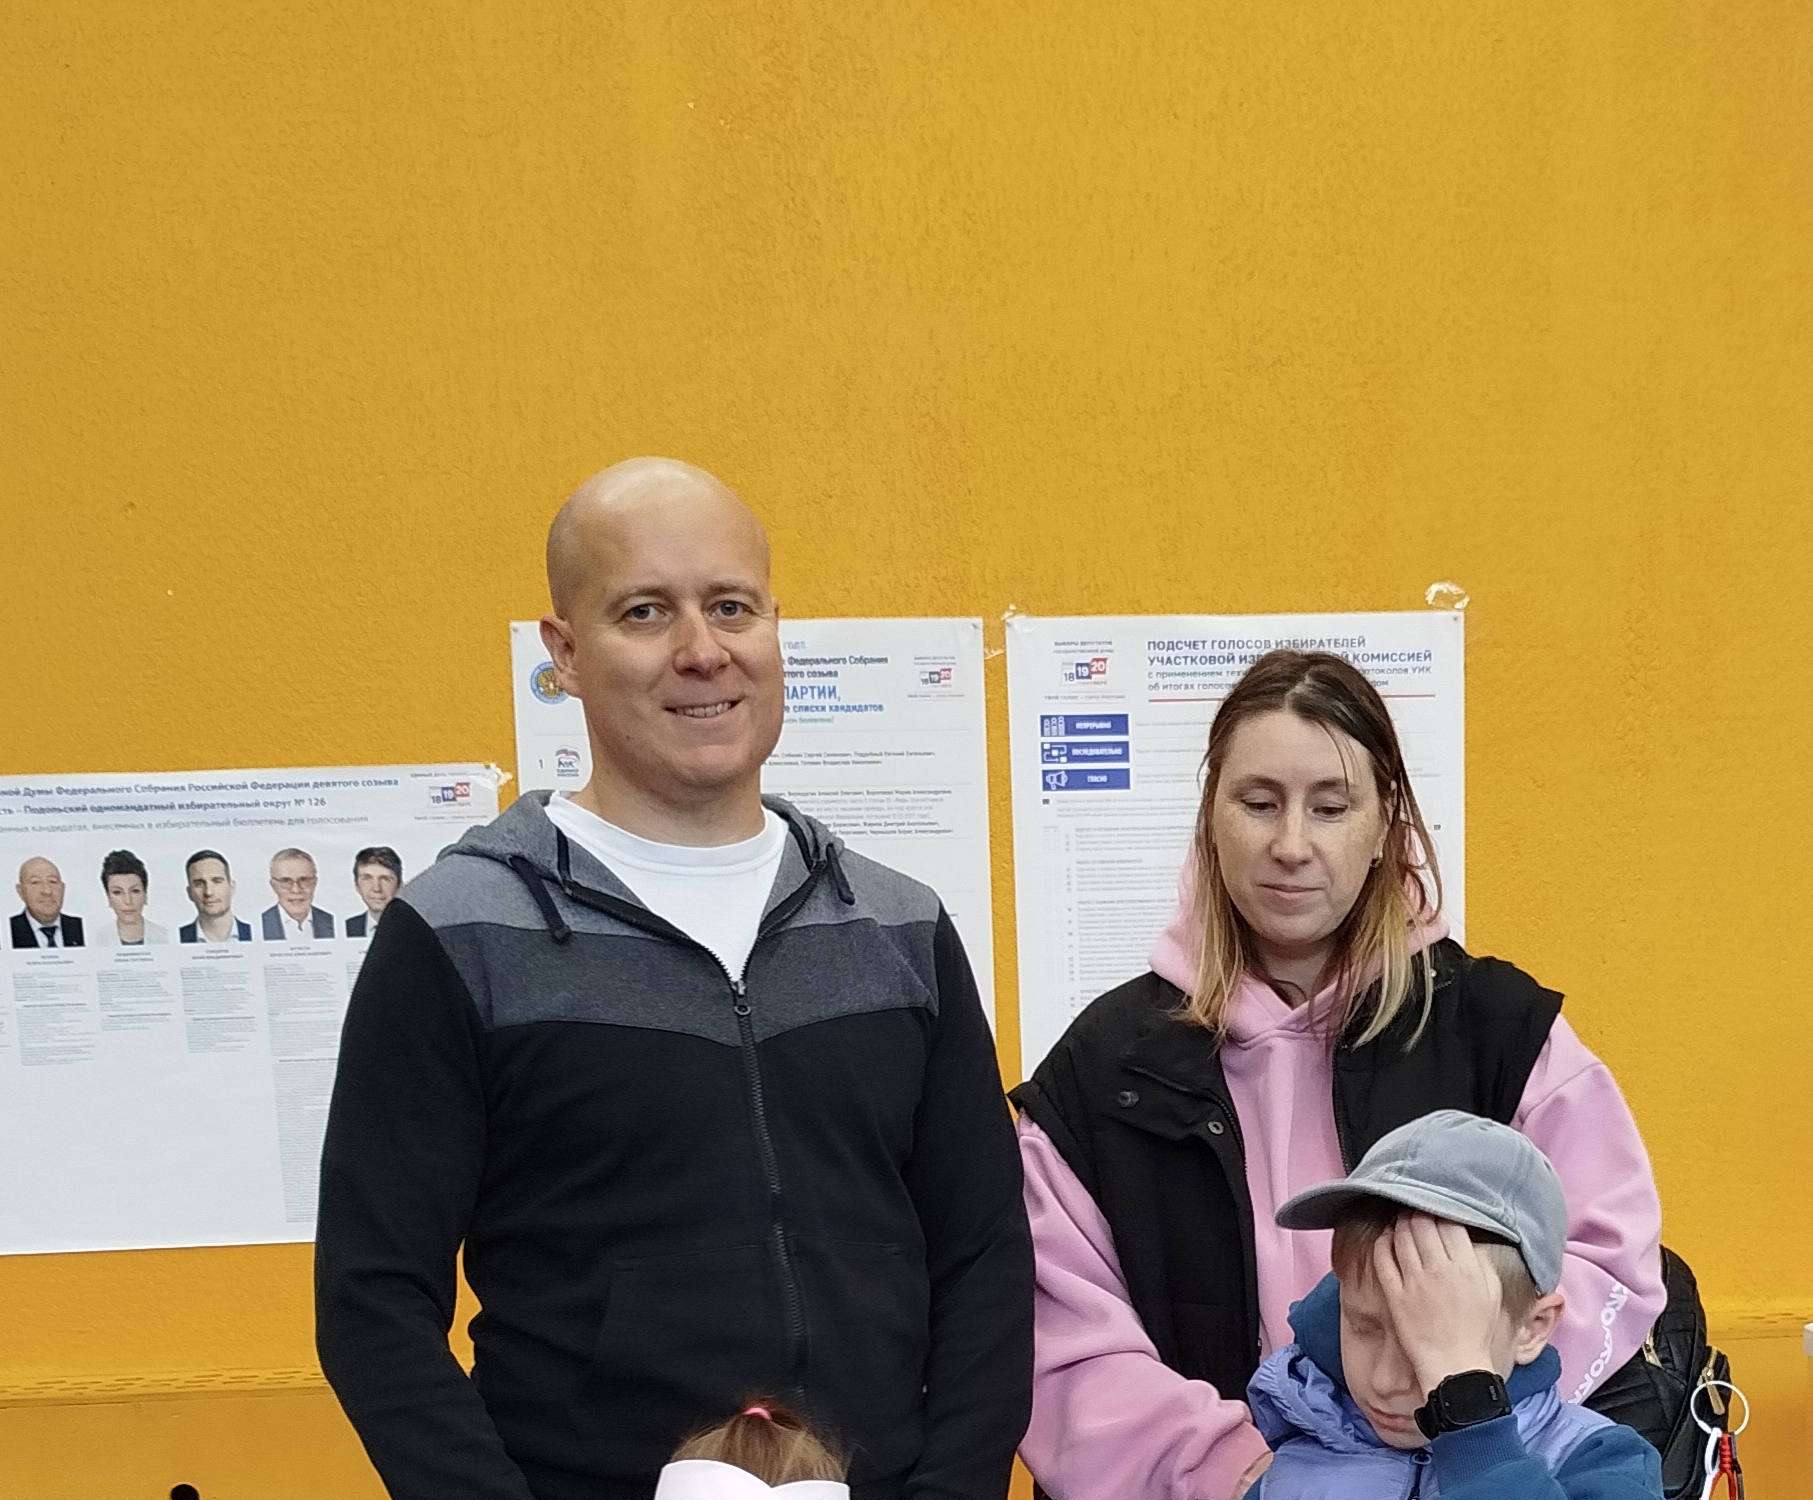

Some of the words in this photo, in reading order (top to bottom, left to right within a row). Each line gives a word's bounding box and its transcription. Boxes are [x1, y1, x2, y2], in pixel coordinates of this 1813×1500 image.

[1147, 640, 1207, 651] ПОДСЧЕТ
[1211, 639, 1271, 650] ГОЛОСОВ
[1275, 636, 1366, 649] ИЗБИРАТЕЛЕЙ
[1147, 652, 1236, 666] УЧАСТКОВОЙ
[1352, 650, 1432, 663] КОМИССИЕЙ
[1064, 672, 1075, 682] 18
[1077, 666, 1089, 677] 19
[1091, 660, 1105, 672] 20
[23, 787, 54, 798] Думы
[134, 784, 187, 794] Собрания
[188, 782, 249, 792] Российской
[250, 781, 311, 791] Федерации
[312, 780, 360, 789] девятого
[361, 779, 399, 787] созыва
[430, 795, 442, 804] 18
[443, 789, 454, 800] 19
[455, 784, 469, 795] 20
[177, 800, 261, 811] избирательный
[262, 801, 291, 809] округ
[307, 798, 327, 807] 126
